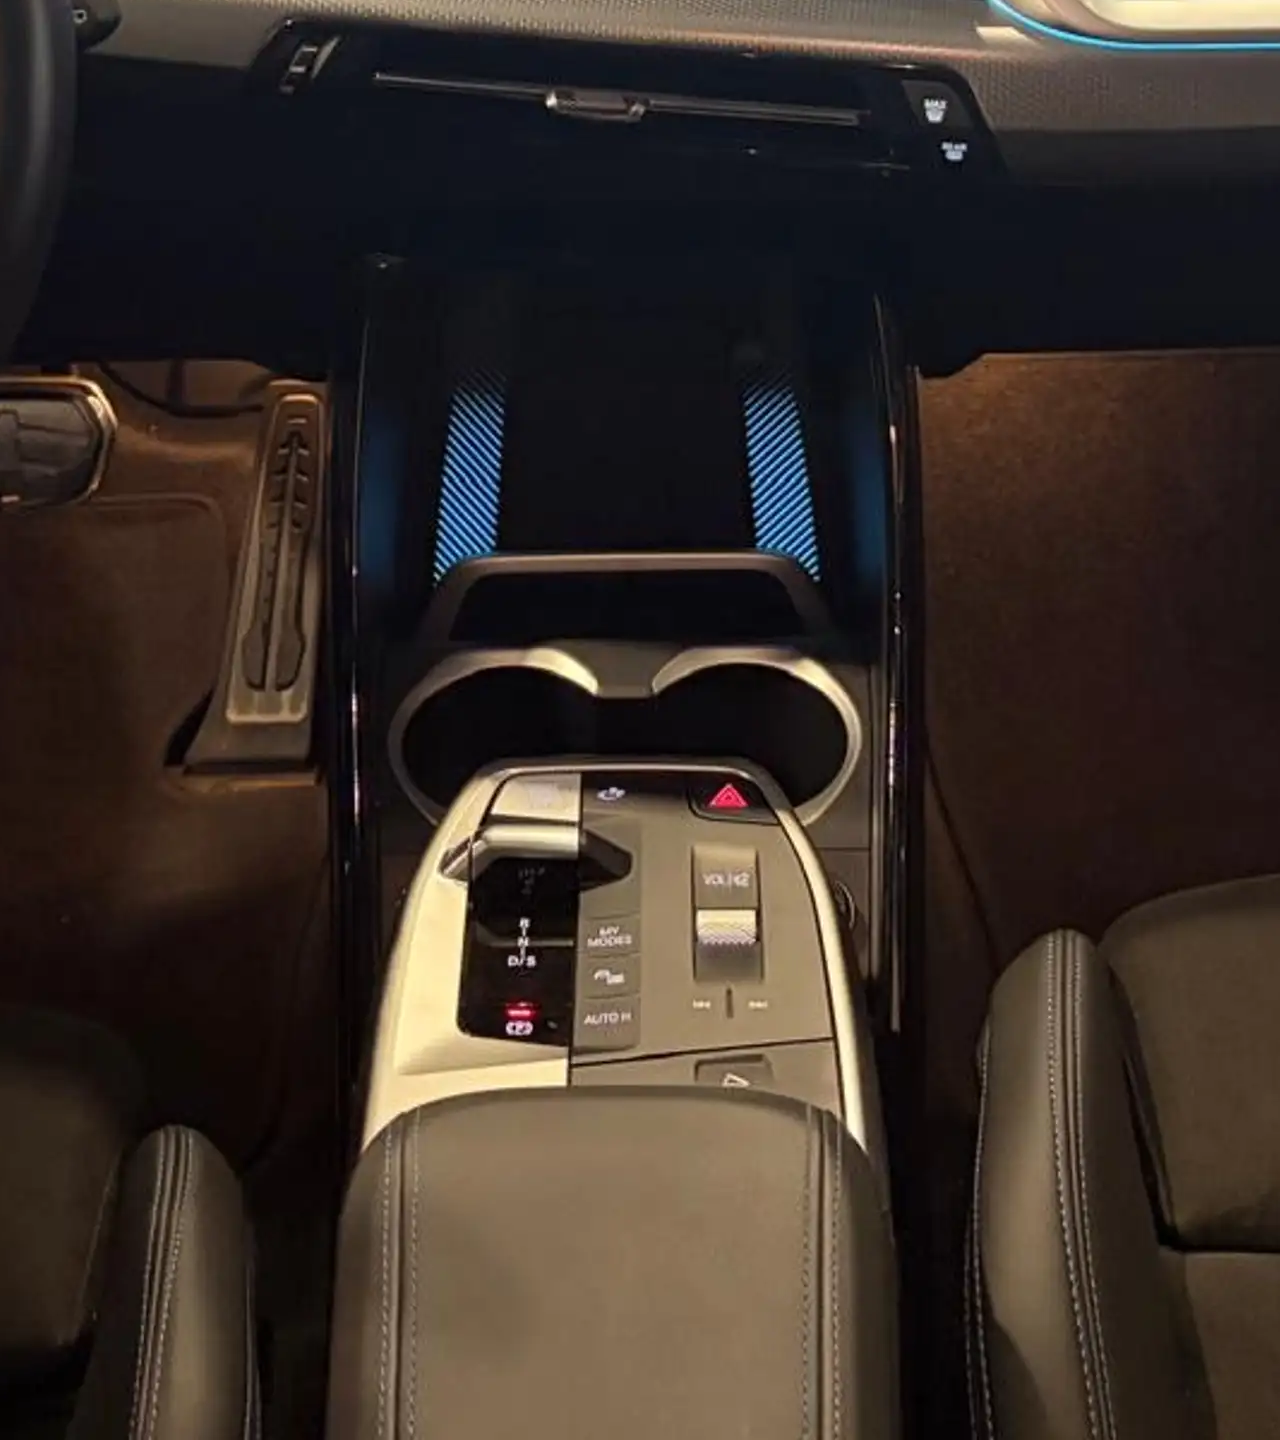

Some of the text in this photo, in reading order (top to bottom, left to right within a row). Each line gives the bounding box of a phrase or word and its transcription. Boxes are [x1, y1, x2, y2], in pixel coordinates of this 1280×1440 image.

[587, 935, 632, 947] MODES
[584, 1011, 632, 1025] AUTO H
